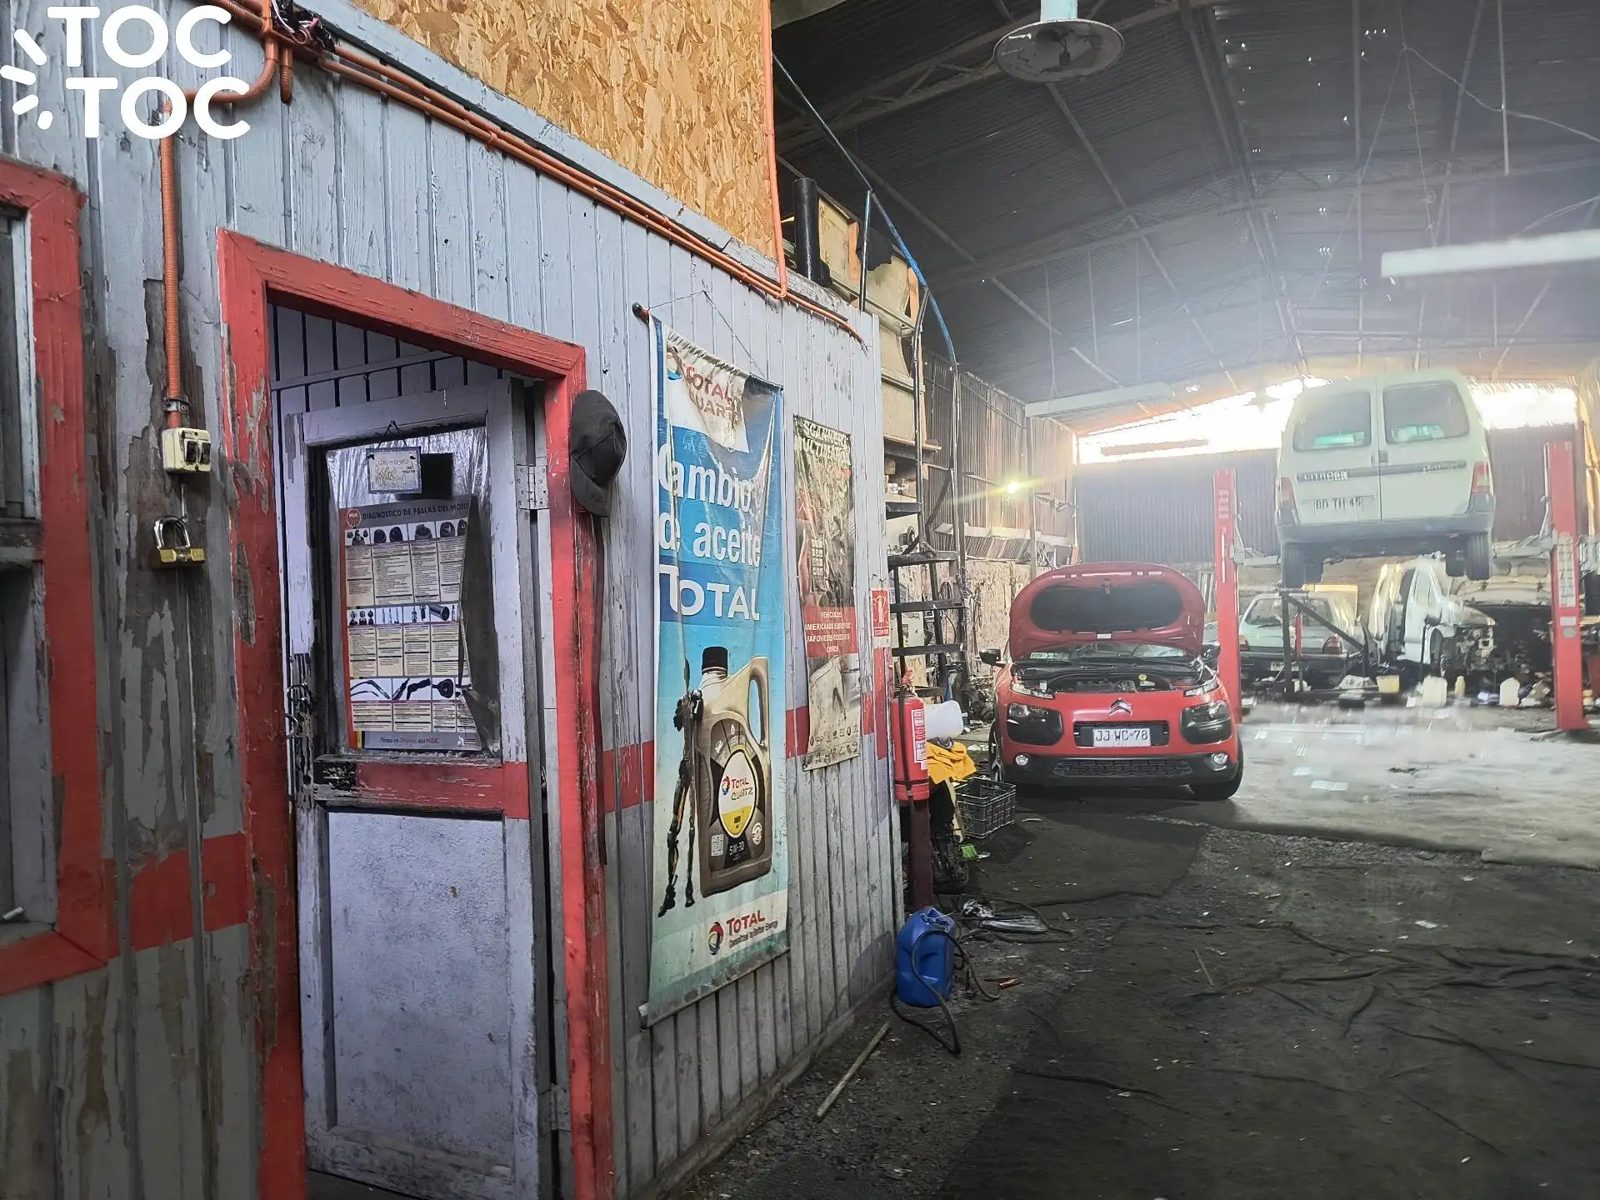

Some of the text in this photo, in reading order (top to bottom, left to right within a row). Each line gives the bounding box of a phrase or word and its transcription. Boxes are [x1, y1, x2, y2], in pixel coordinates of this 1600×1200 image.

[684, 364, 733, 405] TOTAL
[362, 509, 401, 520] DIAGNOSTICO
[403, 507, 412, 516] DE
[413, 504, 437, 515] FALLAS
[693, 522, 760, 567] aceite
[659, 563, 760, 621] TOTAL
[731, 777, 750, 789] TOTAL
[726, 909, 766, 936] TOTAL
